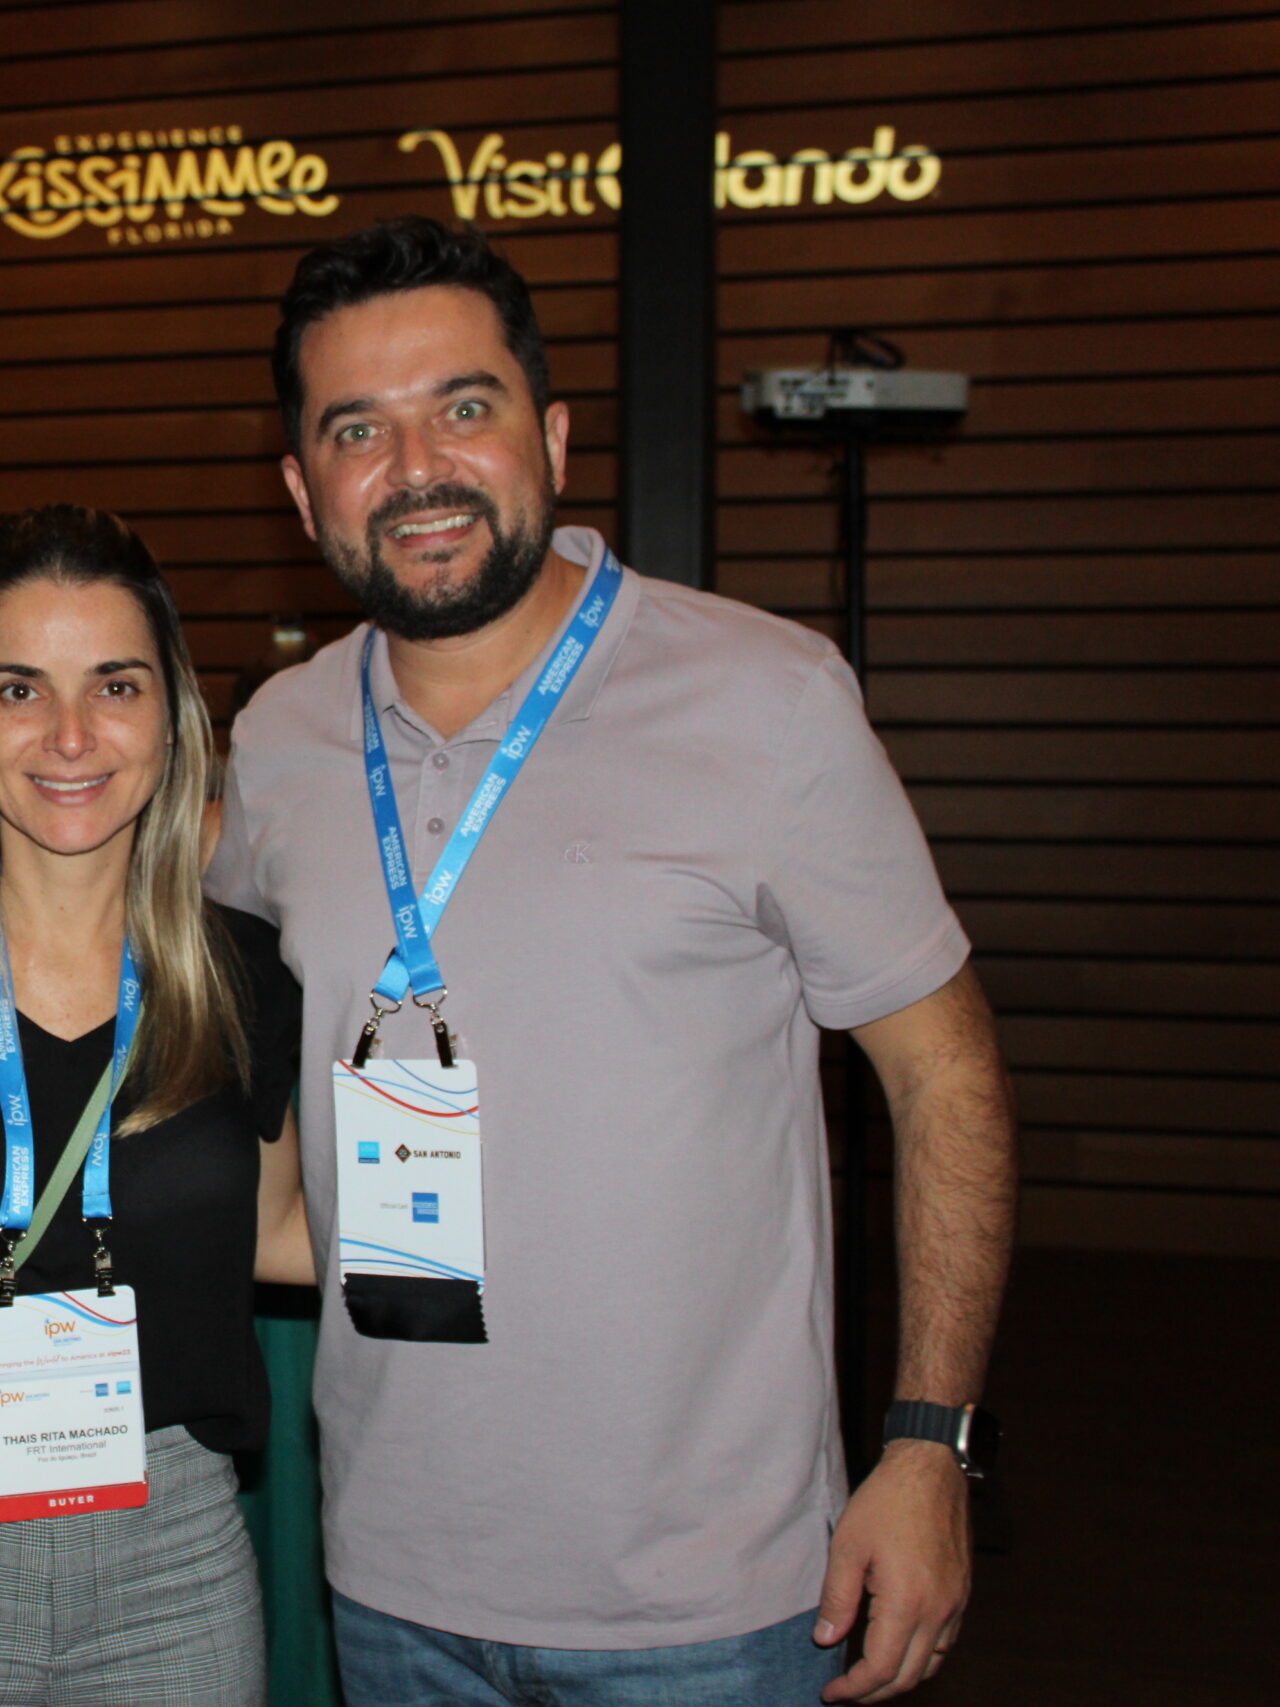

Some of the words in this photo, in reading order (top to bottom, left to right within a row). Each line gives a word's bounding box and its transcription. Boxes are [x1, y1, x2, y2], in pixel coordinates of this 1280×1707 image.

[54, 124, 242, 154] EXPERIENCE
[397, 129, 595, 220] Visit
[595, 126, 942, 209] lando
[107, 218, 233, 245] FLORIDA
[579, 595, 605, 628] ipw
[537, 636, 575, 696] AMERICAN
[550, 641, 584, 694] EXPRESS
[500, 725, 532, 760] ipw
[459, 773, 498, 838] AMERICAN
[471, 777, 507, 833] EXPRESS
[382, 836, 398, 890] EXPRESS
[389, 826, 407, 887] AMERICAN
[424, 869, 453, 904] ipw
[396, 904, 418, 938] ipw
[123, 978, 140, 1012] ipw
[7, 1094, 29, 1127] ipw
[91, 1132, 108, 1167] ipw
[413, 1150, 427, 1158] SAN
[430, 1151, 462, 1159] ANTONIO
[10, 1145, 21, 1215] AMERICAN
[19, 1147, 30, 1207] EXPRESS
[44, 1318, 76, 1339] ipw
[3, 1434, 37, 1446] THAIS
[40, 1431, 66, 1442] RITA
[69, 1425, 128, 1439] MACHADO
[26, 1445, 48, 1456] FRT
[49, 1440, 107, 1453] International
[49, 1495, 95, 1507] BUYER
